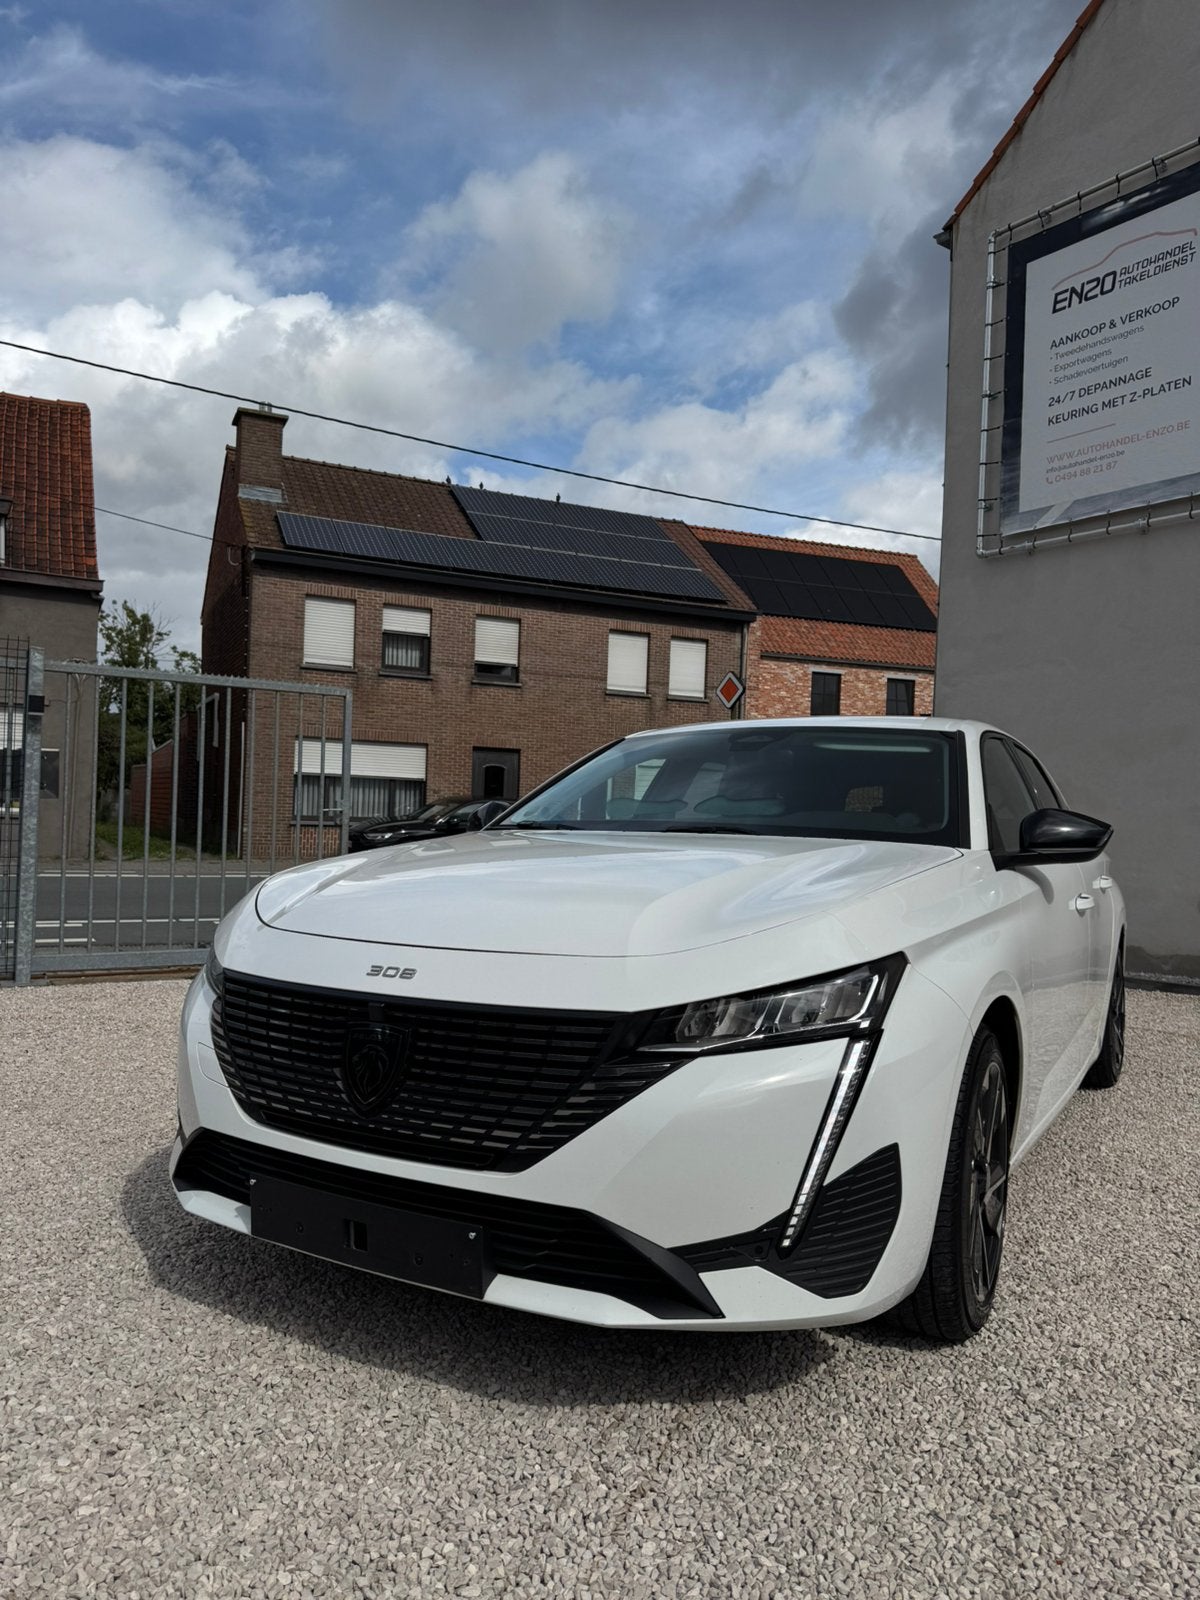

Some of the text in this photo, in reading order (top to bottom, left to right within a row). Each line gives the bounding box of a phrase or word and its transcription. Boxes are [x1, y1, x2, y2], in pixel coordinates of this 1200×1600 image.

[1118, 251, 1196, 289] TAKELDIENST
[1119, 241, 1196, 278] AUTOHANDEL
[1050, 296, 1180, 350] AANKOOP & VERKOOP
[1053, 348, 1113, 373] Exportwagens
[1054, 324, 1145, 361] Tweedehandswagens
[1048, 367, 1153, 407] 24/7 DEPANNAGE
[1053, 355, 1129, 385] Schadevoertuigen
[1047, 376, 1193, 426] KEURING MET Z-PLATEN
[1046, 420, 1191, 465] WWW.AUTOHANDEL-ENZO.BE
[1054, 460, 1119, 483] 0494 88 21 87
[366, 965, 418, 980] 308
